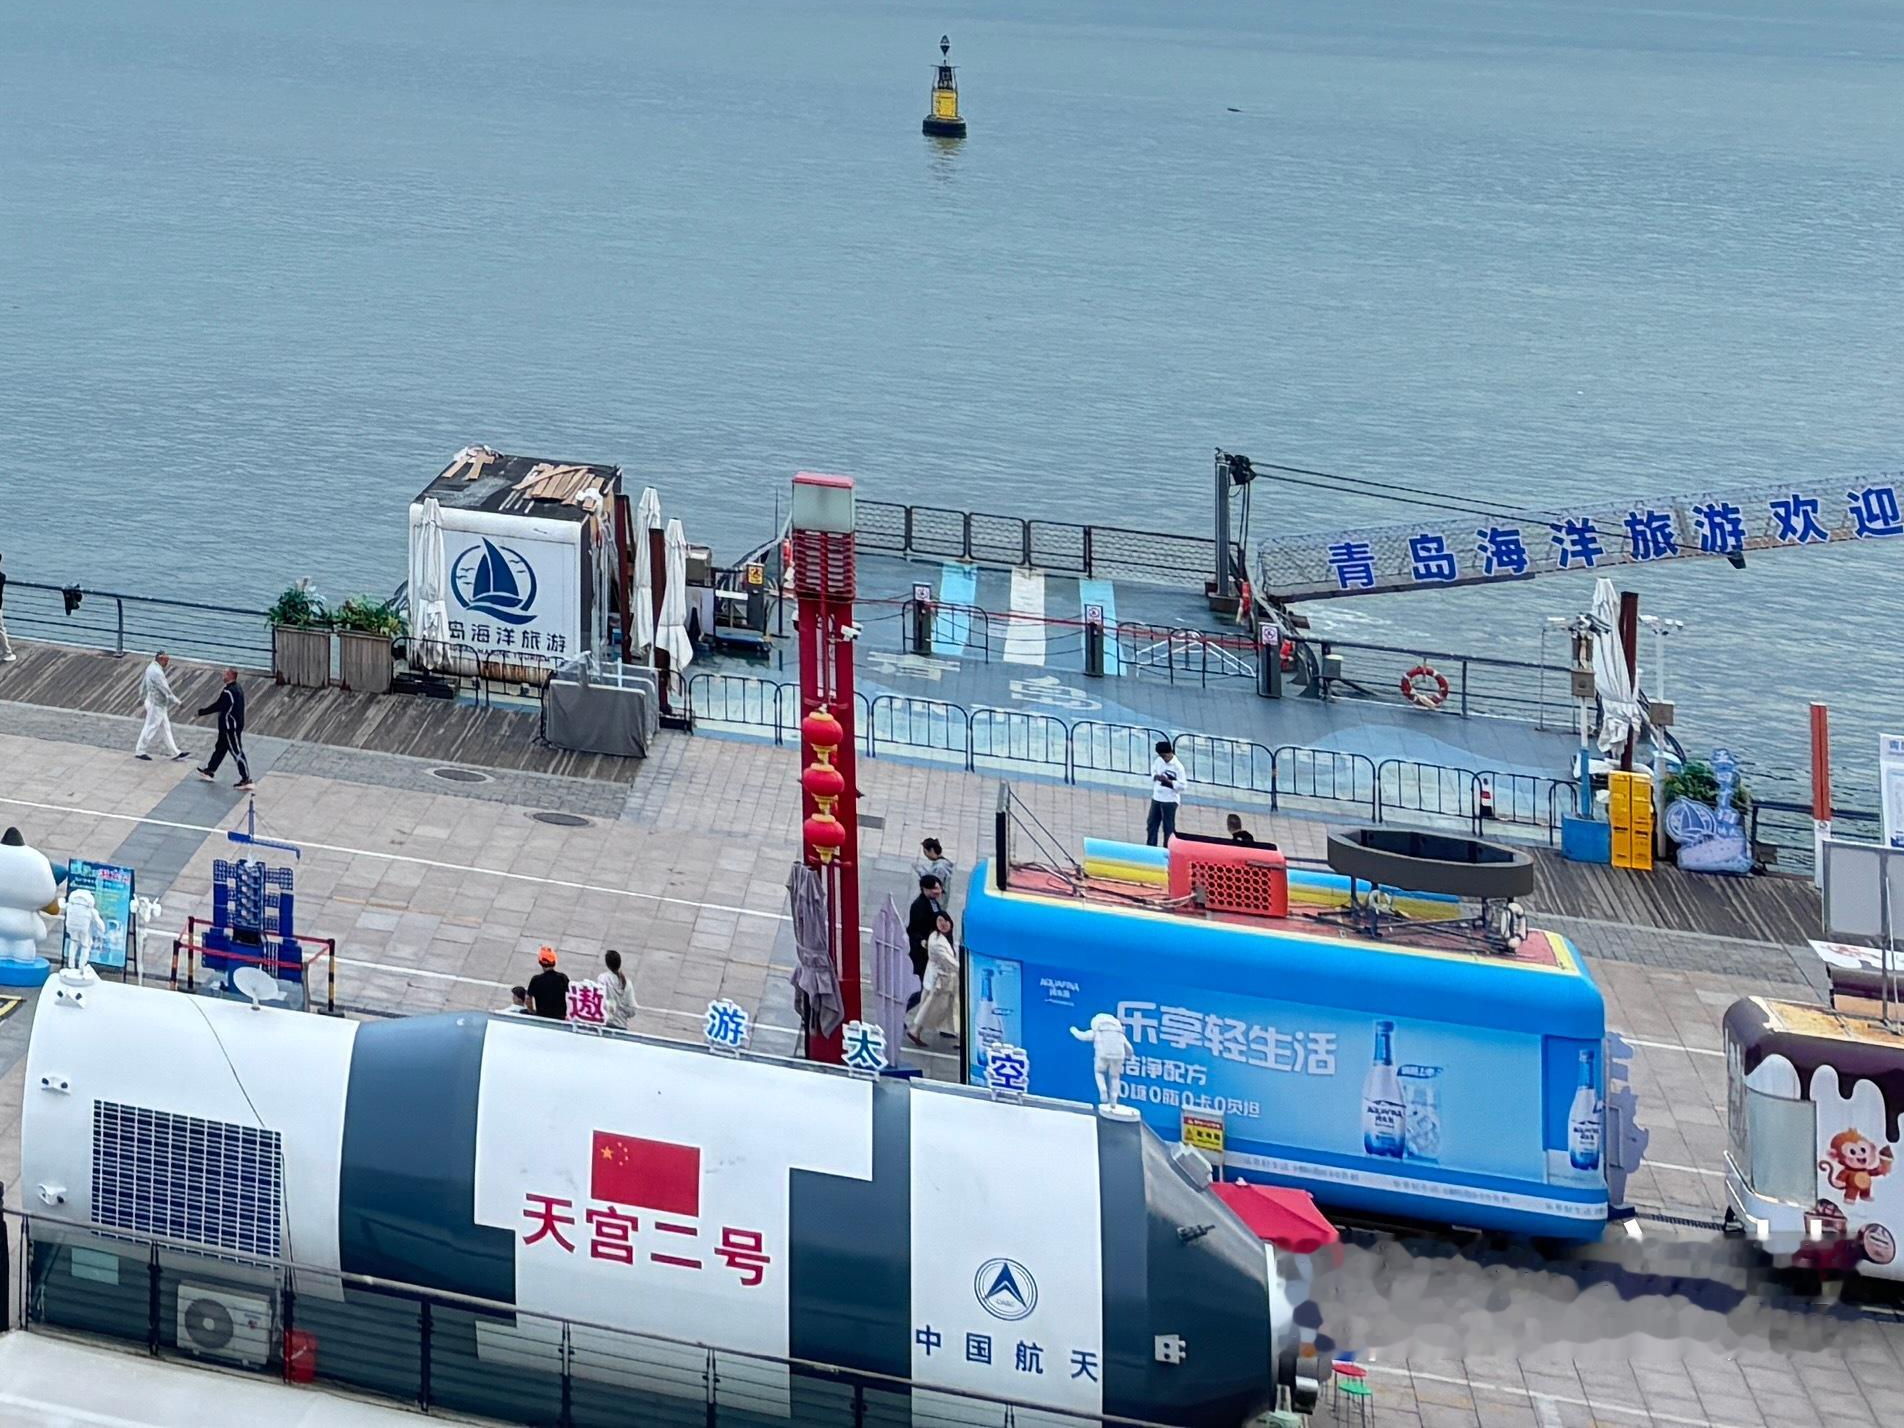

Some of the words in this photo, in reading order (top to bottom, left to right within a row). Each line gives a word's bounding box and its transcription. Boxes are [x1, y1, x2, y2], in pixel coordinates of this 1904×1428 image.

[1327, 487, 1904, 590] 青岛海洋旅游欢迎
[1117, 1001, 1338, 1076] 乐享轻生活
[522, 1192, 772, 1286] 天宫二号
[915, 1324, 1099, 1384] 中国航天
